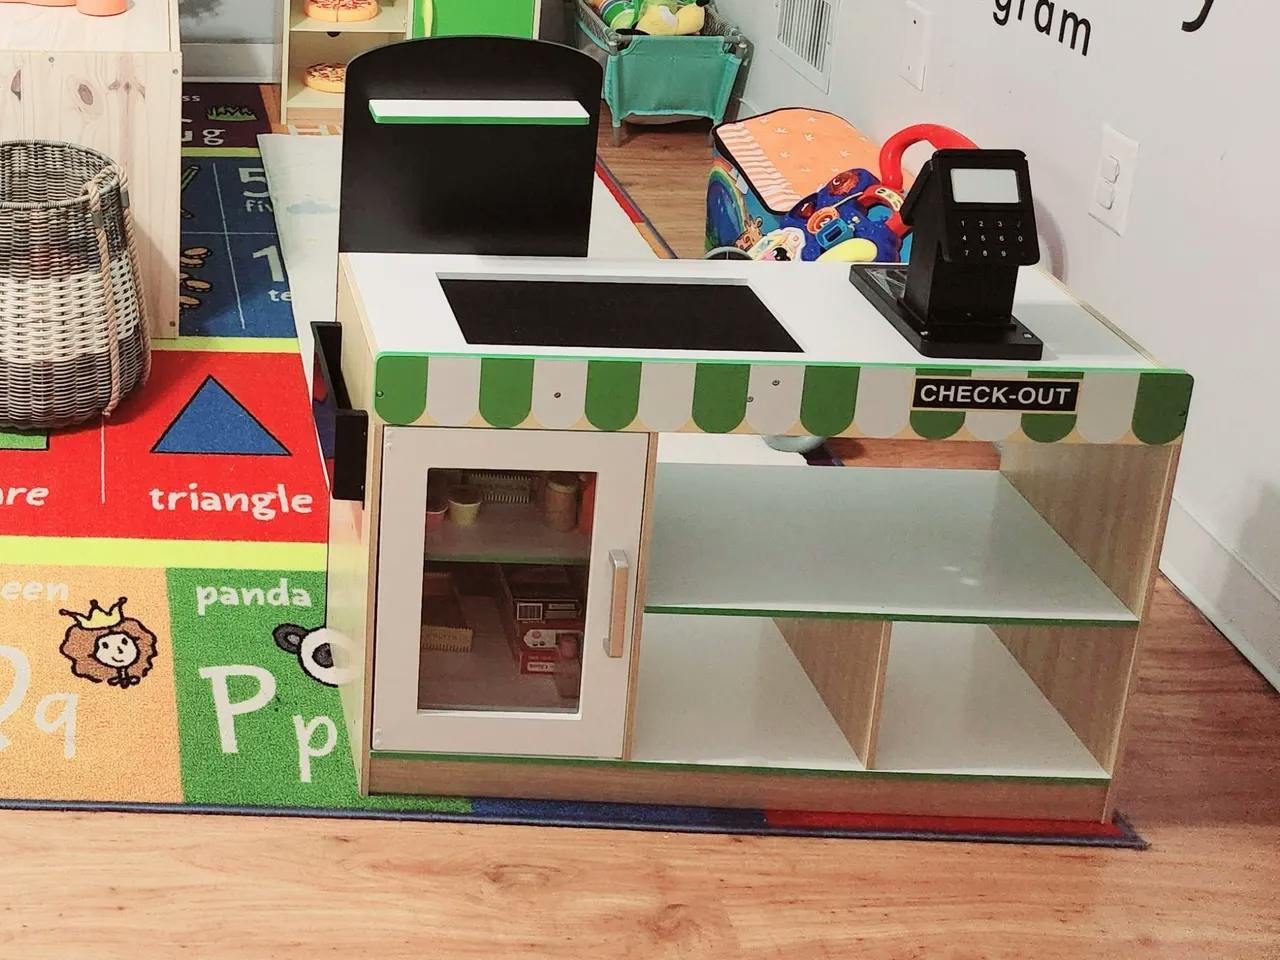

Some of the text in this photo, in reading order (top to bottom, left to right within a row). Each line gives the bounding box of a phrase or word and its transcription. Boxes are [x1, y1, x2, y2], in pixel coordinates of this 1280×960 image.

[239, 167, 269, 198] 5
[268, 289, 292, 302] te
[921, 385, 1070, 404] CHECK-OUT
[150, 484, 312, 520] triangle
[196, 578, 311, 615] panda
